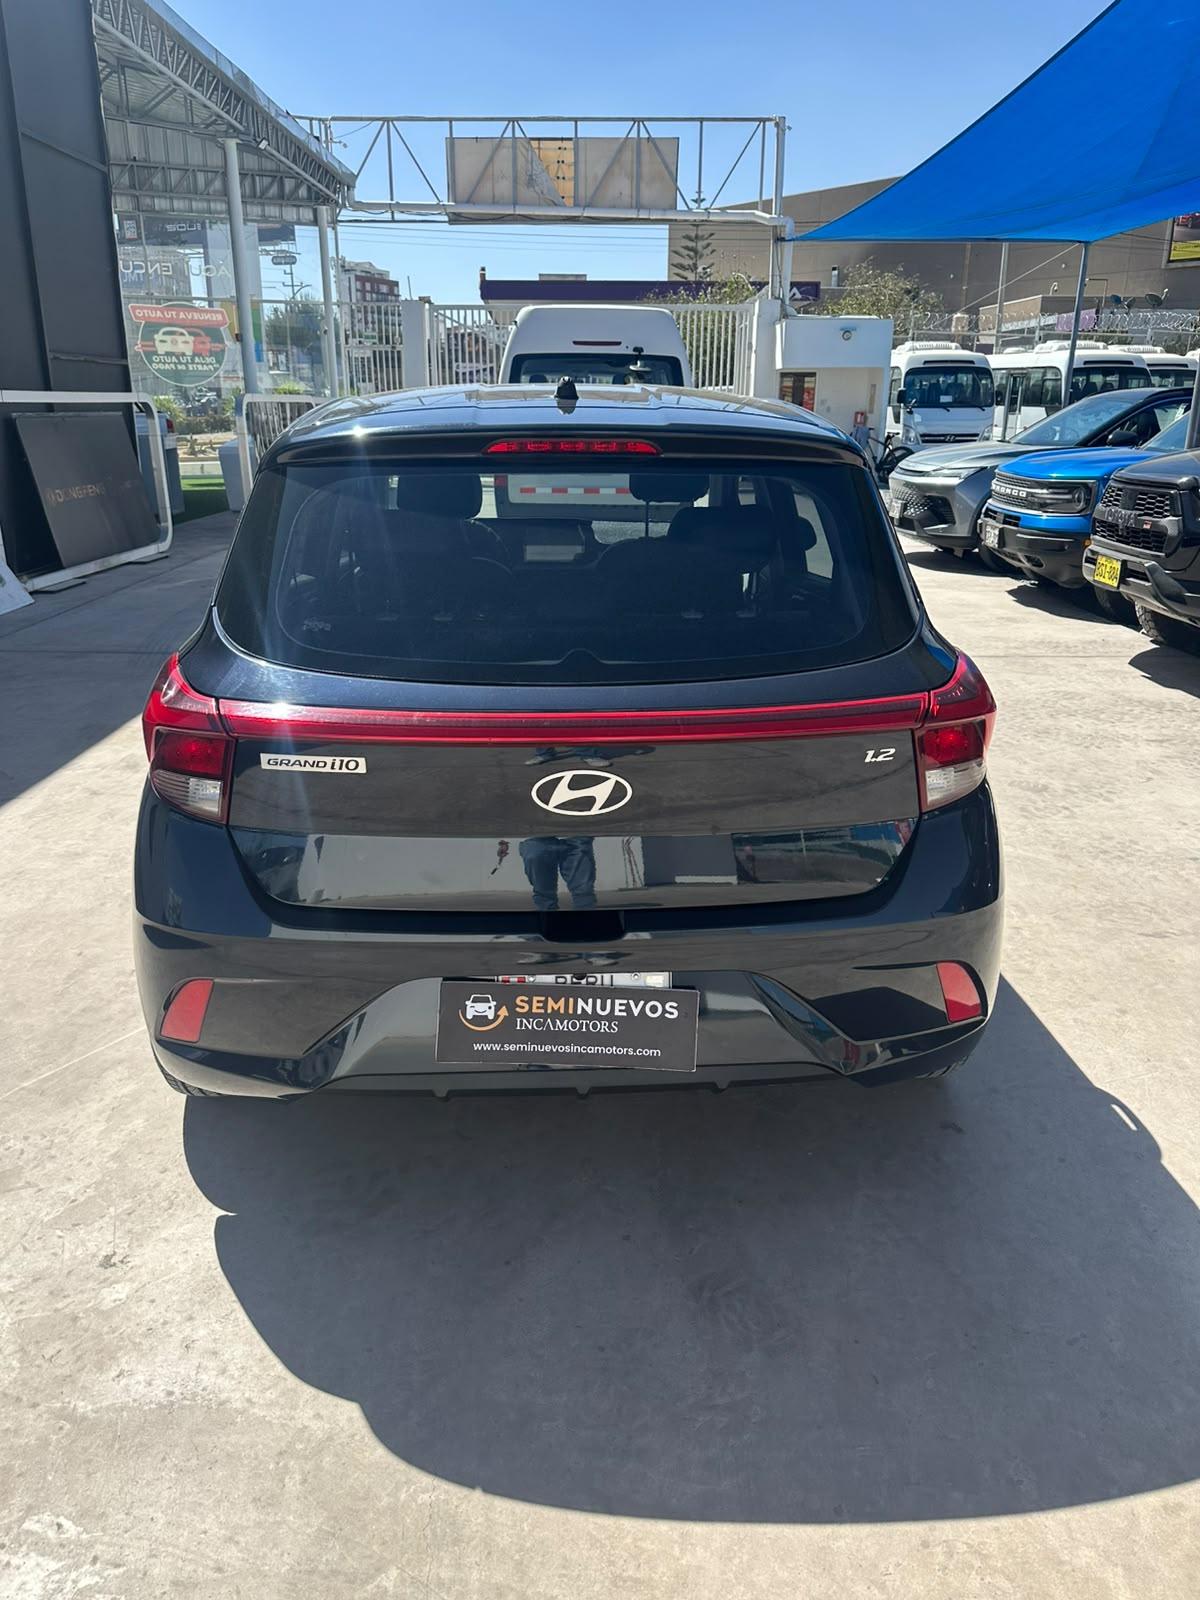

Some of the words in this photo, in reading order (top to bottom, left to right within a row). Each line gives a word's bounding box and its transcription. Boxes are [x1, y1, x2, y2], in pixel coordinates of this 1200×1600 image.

[864, 748, 896, 763] 1.2
[267, 758, 328, 769] GRAND
[330, 758, 360, 771] i10
[515, 995, 679, 1019] SEMINUEVOS
[515, 1018, 619, 1034] INCAMOTORS
[473, 1041, 662, 1058] www.seminuevosincamotors.com
